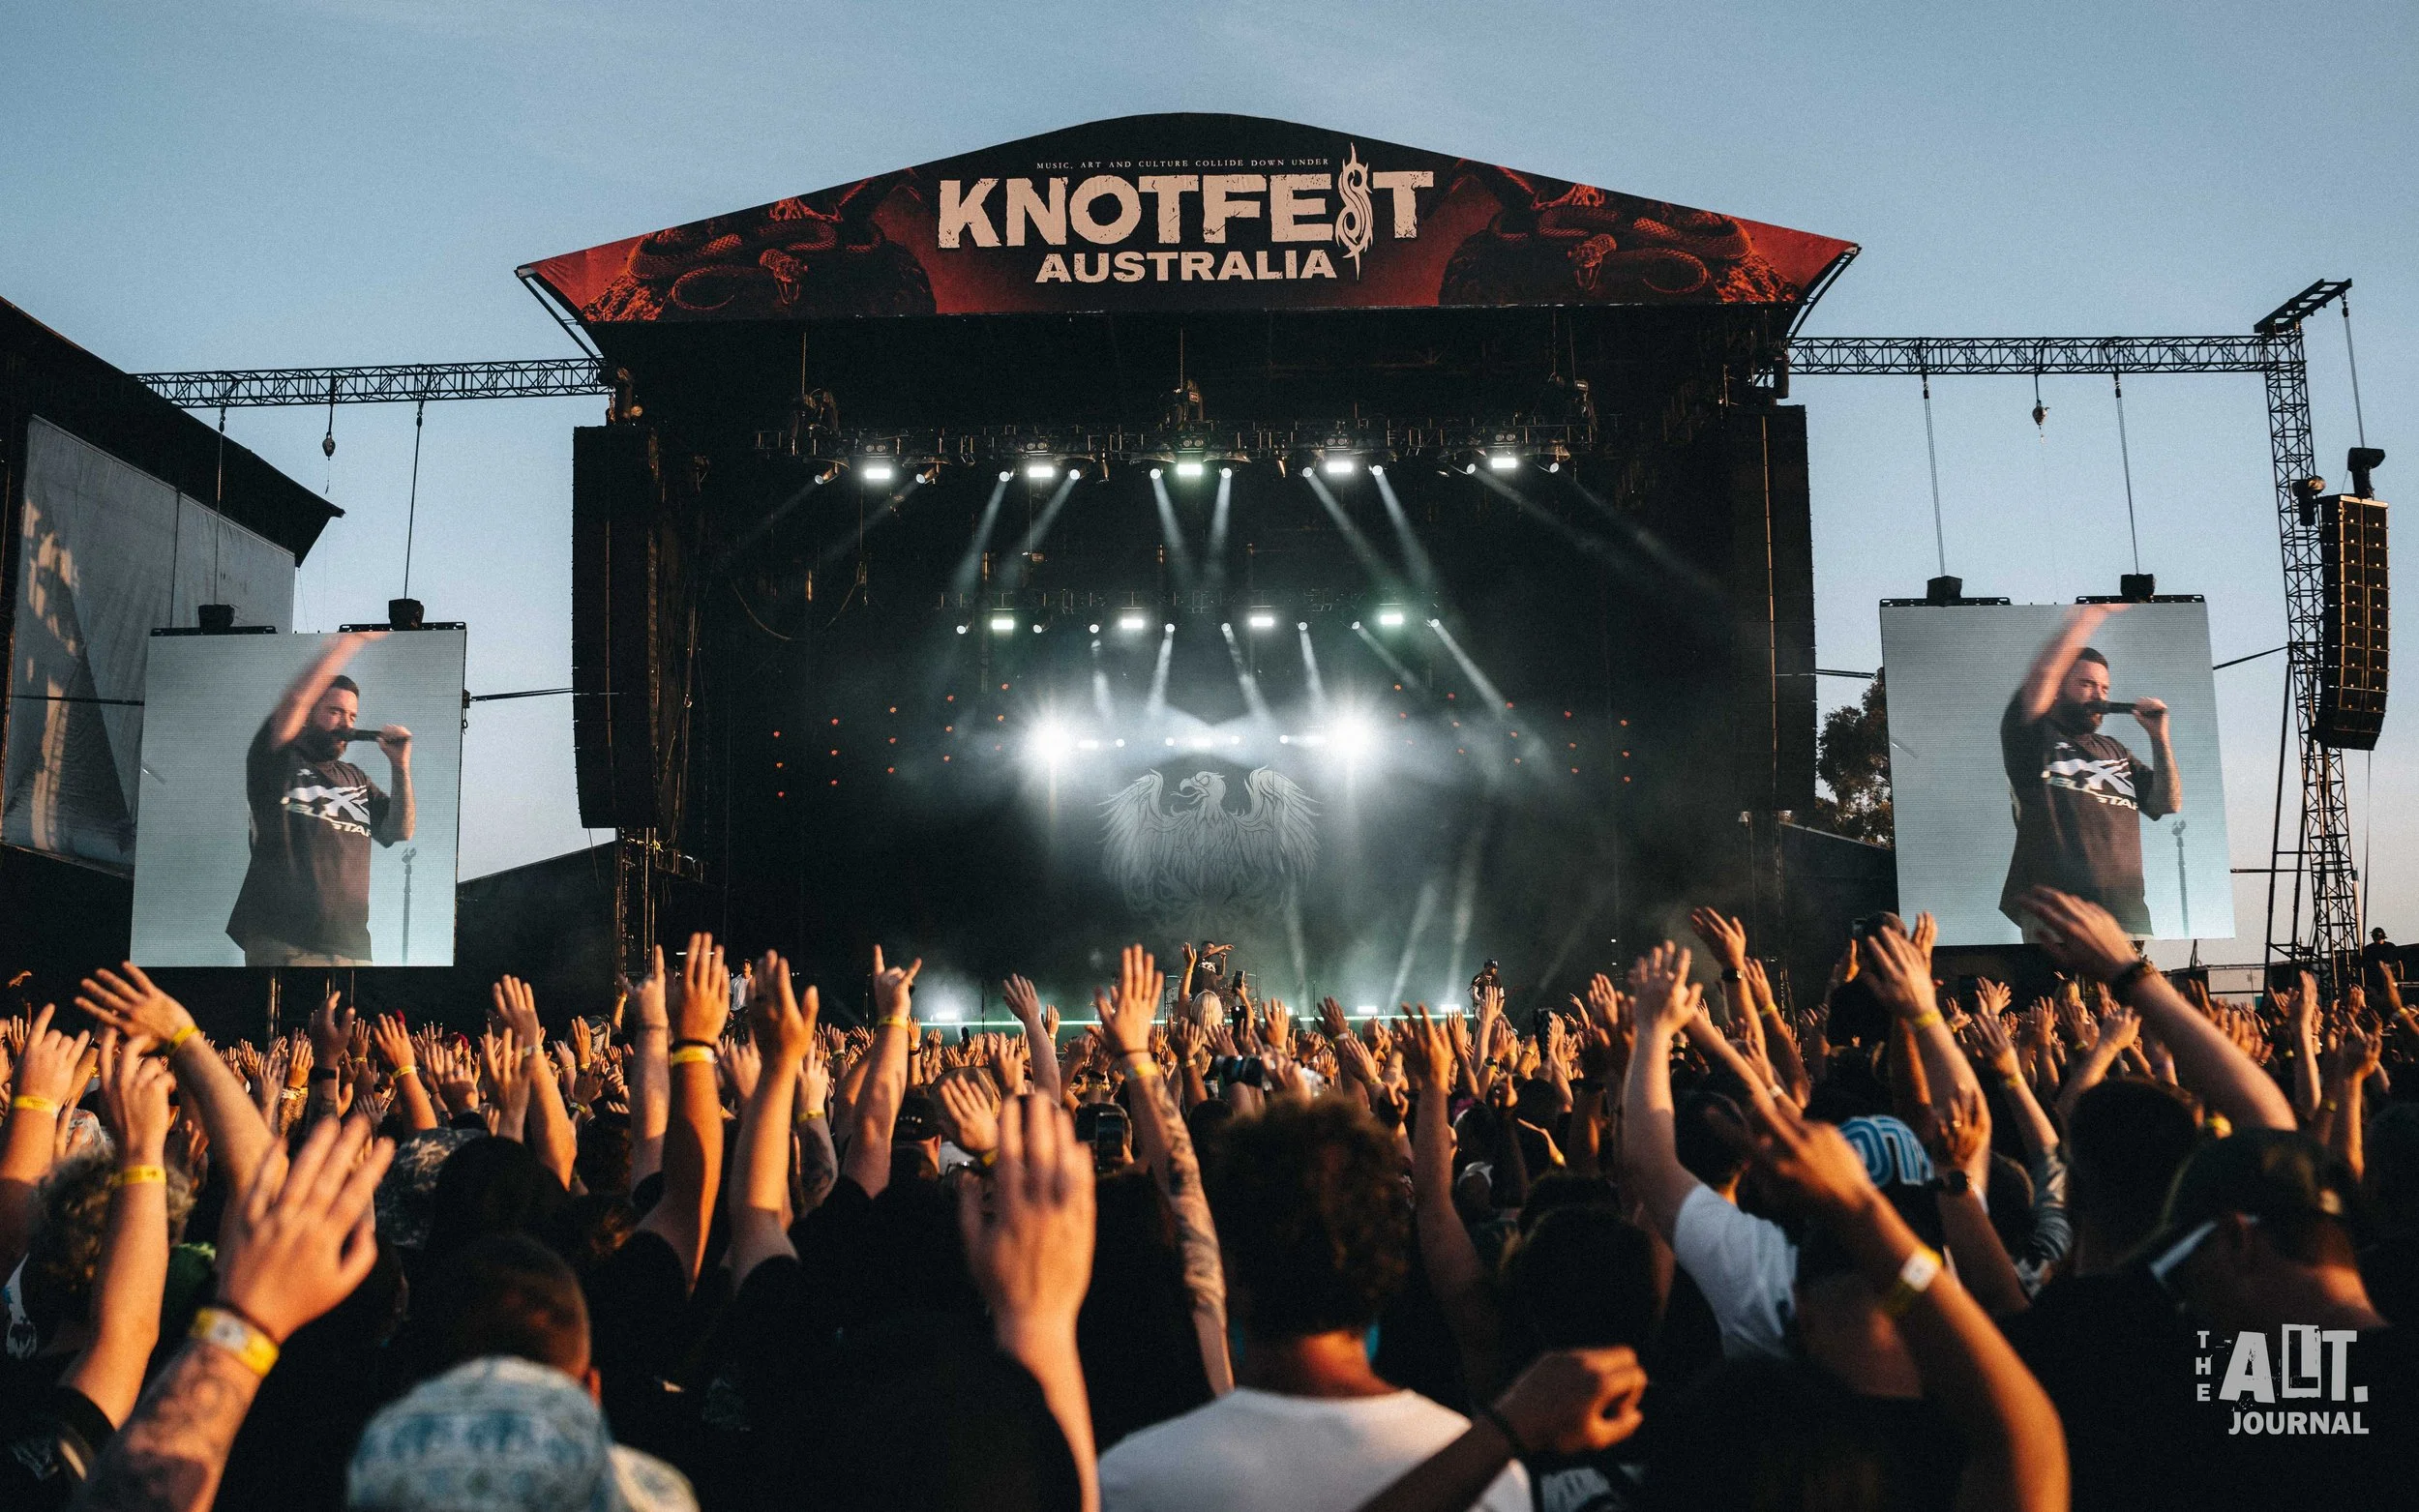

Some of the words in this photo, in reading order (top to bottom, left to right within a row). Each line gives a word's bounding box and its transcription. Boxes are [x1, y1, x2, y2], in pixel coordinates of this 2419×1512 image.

[1195, 159, 1244, 167] COLLIDE
[938, 142, 1434, 281] KNOTFEST
[1035, 250, 1337, 282] AUSTRALIA
